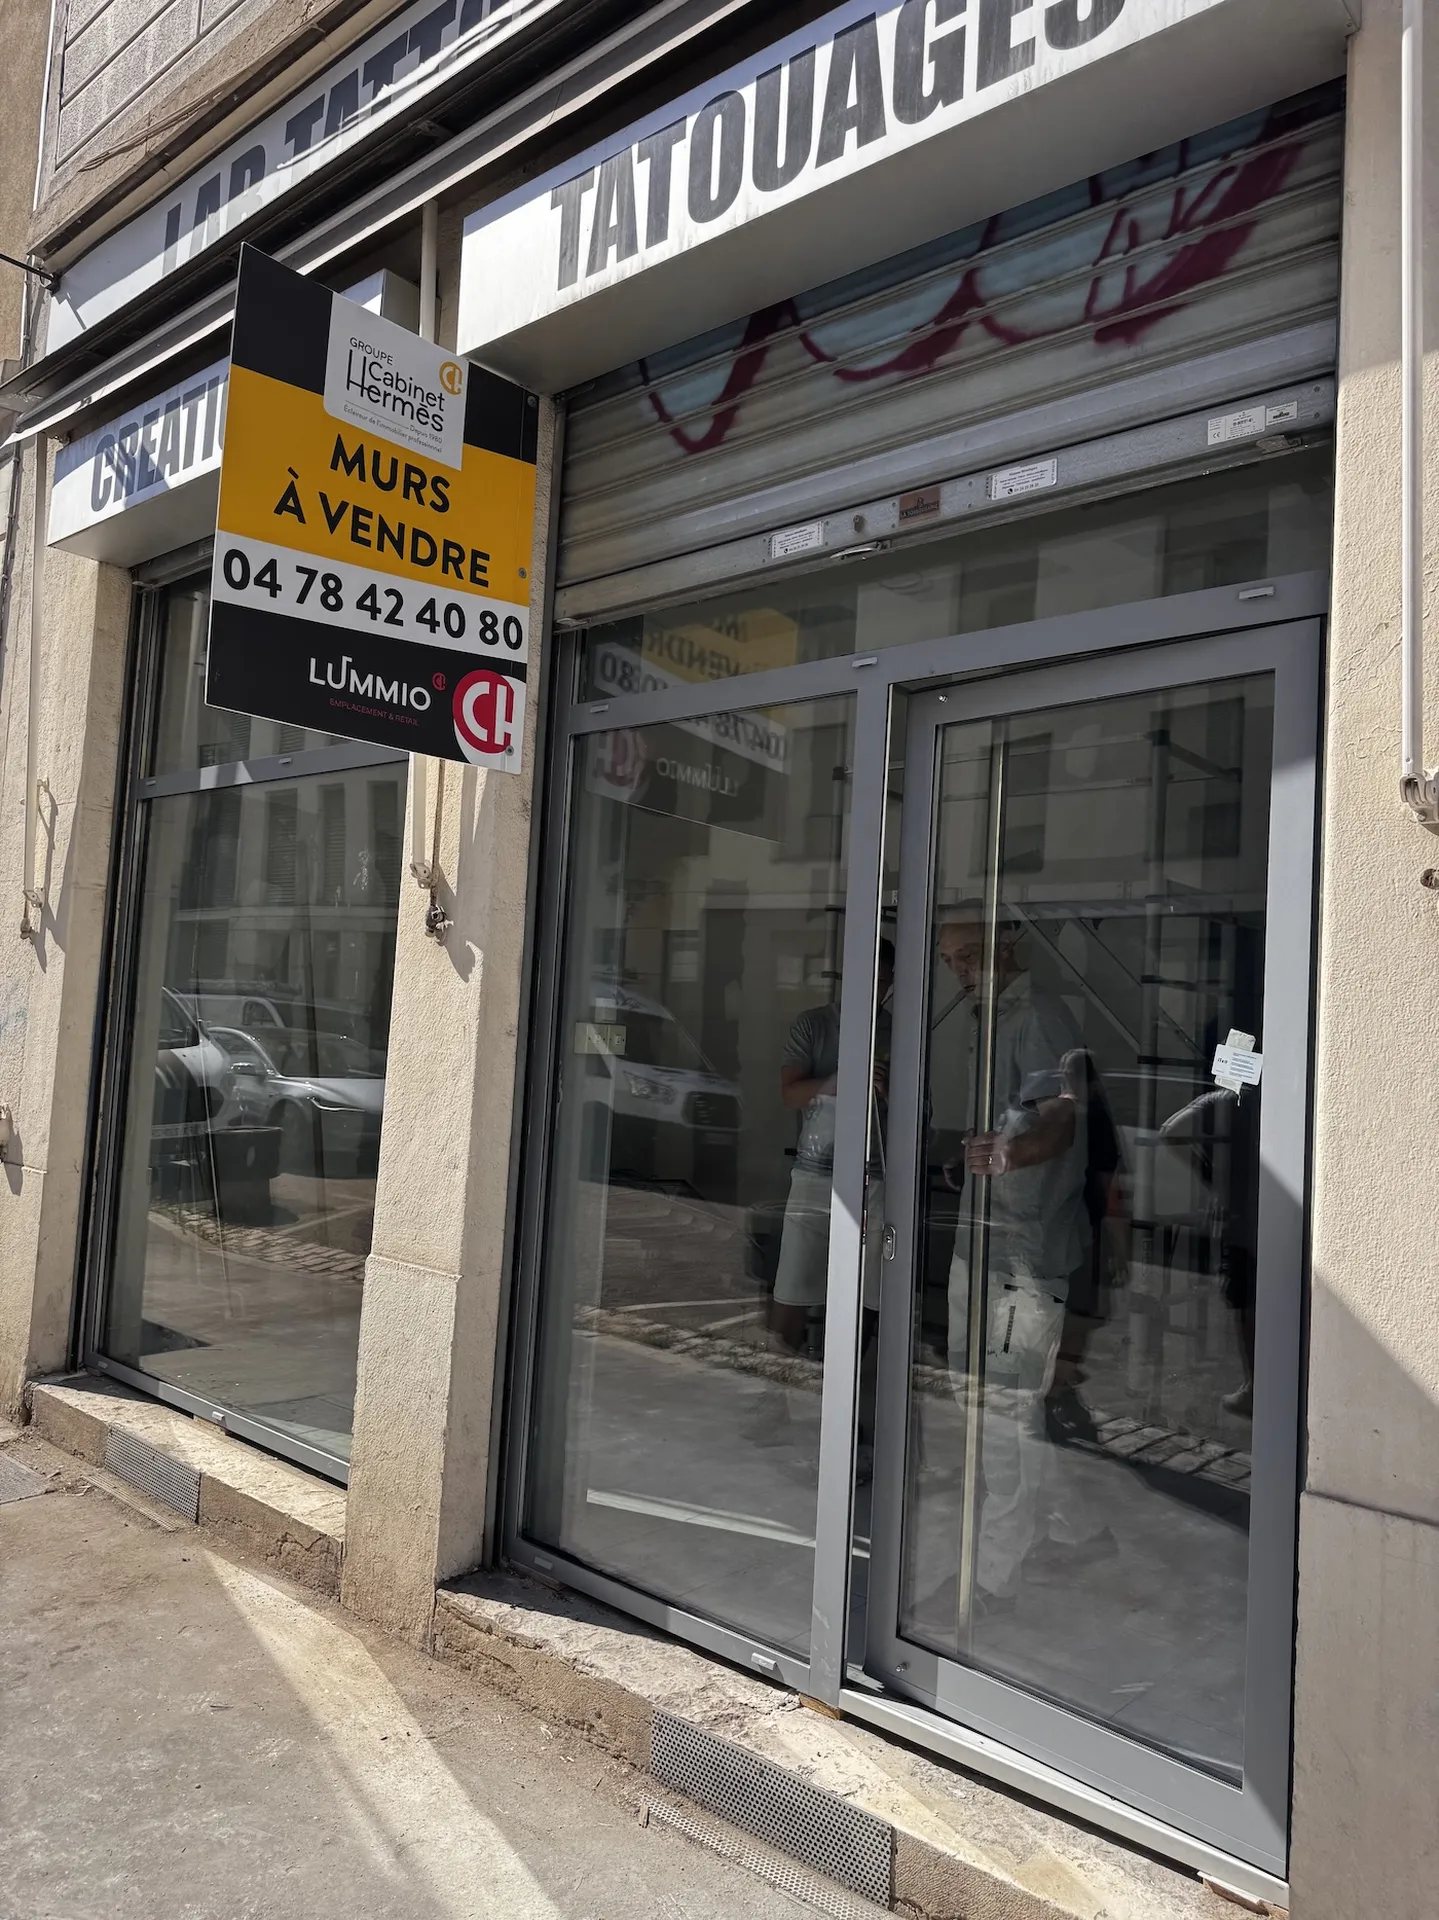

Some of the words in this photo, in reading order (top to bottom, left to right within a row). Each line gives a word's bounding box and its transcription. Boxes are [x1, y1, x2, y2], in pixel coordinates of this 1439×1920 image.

[349, 336, 394, 366] GROUPE
[368, 361, 446, 412] Cabinet
[408, 434, 443, 454] professionnel
[428, 432, 443, 444] 1980
[330, 433, 451, 513] MURS
[273, 466, 307, 524] À
[318, 491, 491, 588] VENDRE
[223, 548, 282, 598] 04
[295, 565, 344, 612] 78
[356, 583, 404, 627] 42
[415, 597, 466, 638] 40
[479, 610, 523, 650] 80
[309, 655, 432, 712] LUMMIO
[329, 697, 388, 719] EMPLACEMENT
[395, 714, 420, 727] RETAIL
